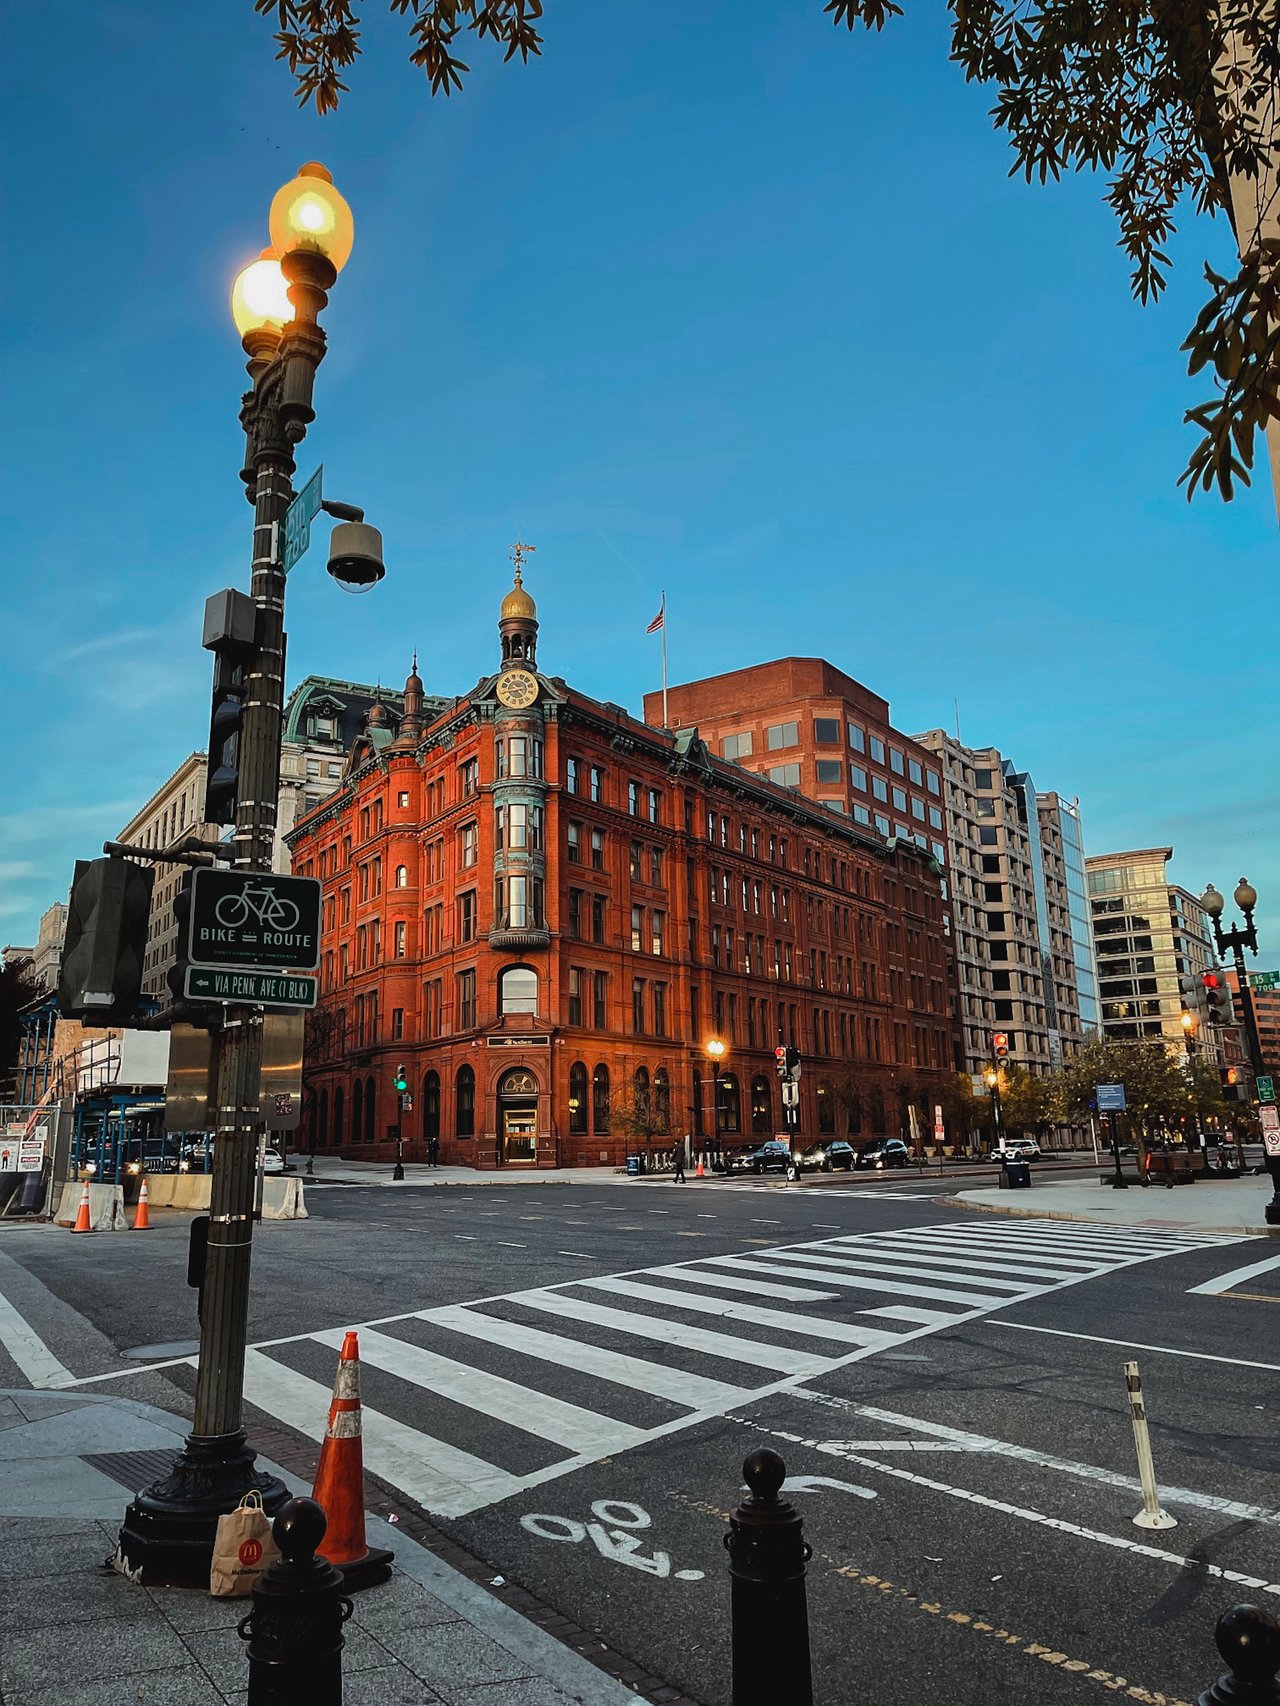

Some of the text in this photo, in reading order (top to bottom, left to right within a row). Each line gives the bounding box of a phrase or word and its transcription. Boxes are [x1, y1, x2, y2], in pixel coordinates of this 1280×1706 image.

[284, 527, 308, 568] 700
[200, 928, 311, 947] BIKE ROUTE
[215, 975, 229, 993] VIA
[260, 978, 277, 997] AVE
[279, 980, 286, 998] (1
[288, 981, 308, 999] BLK)
[1257, 984, 1273, 992] 700
